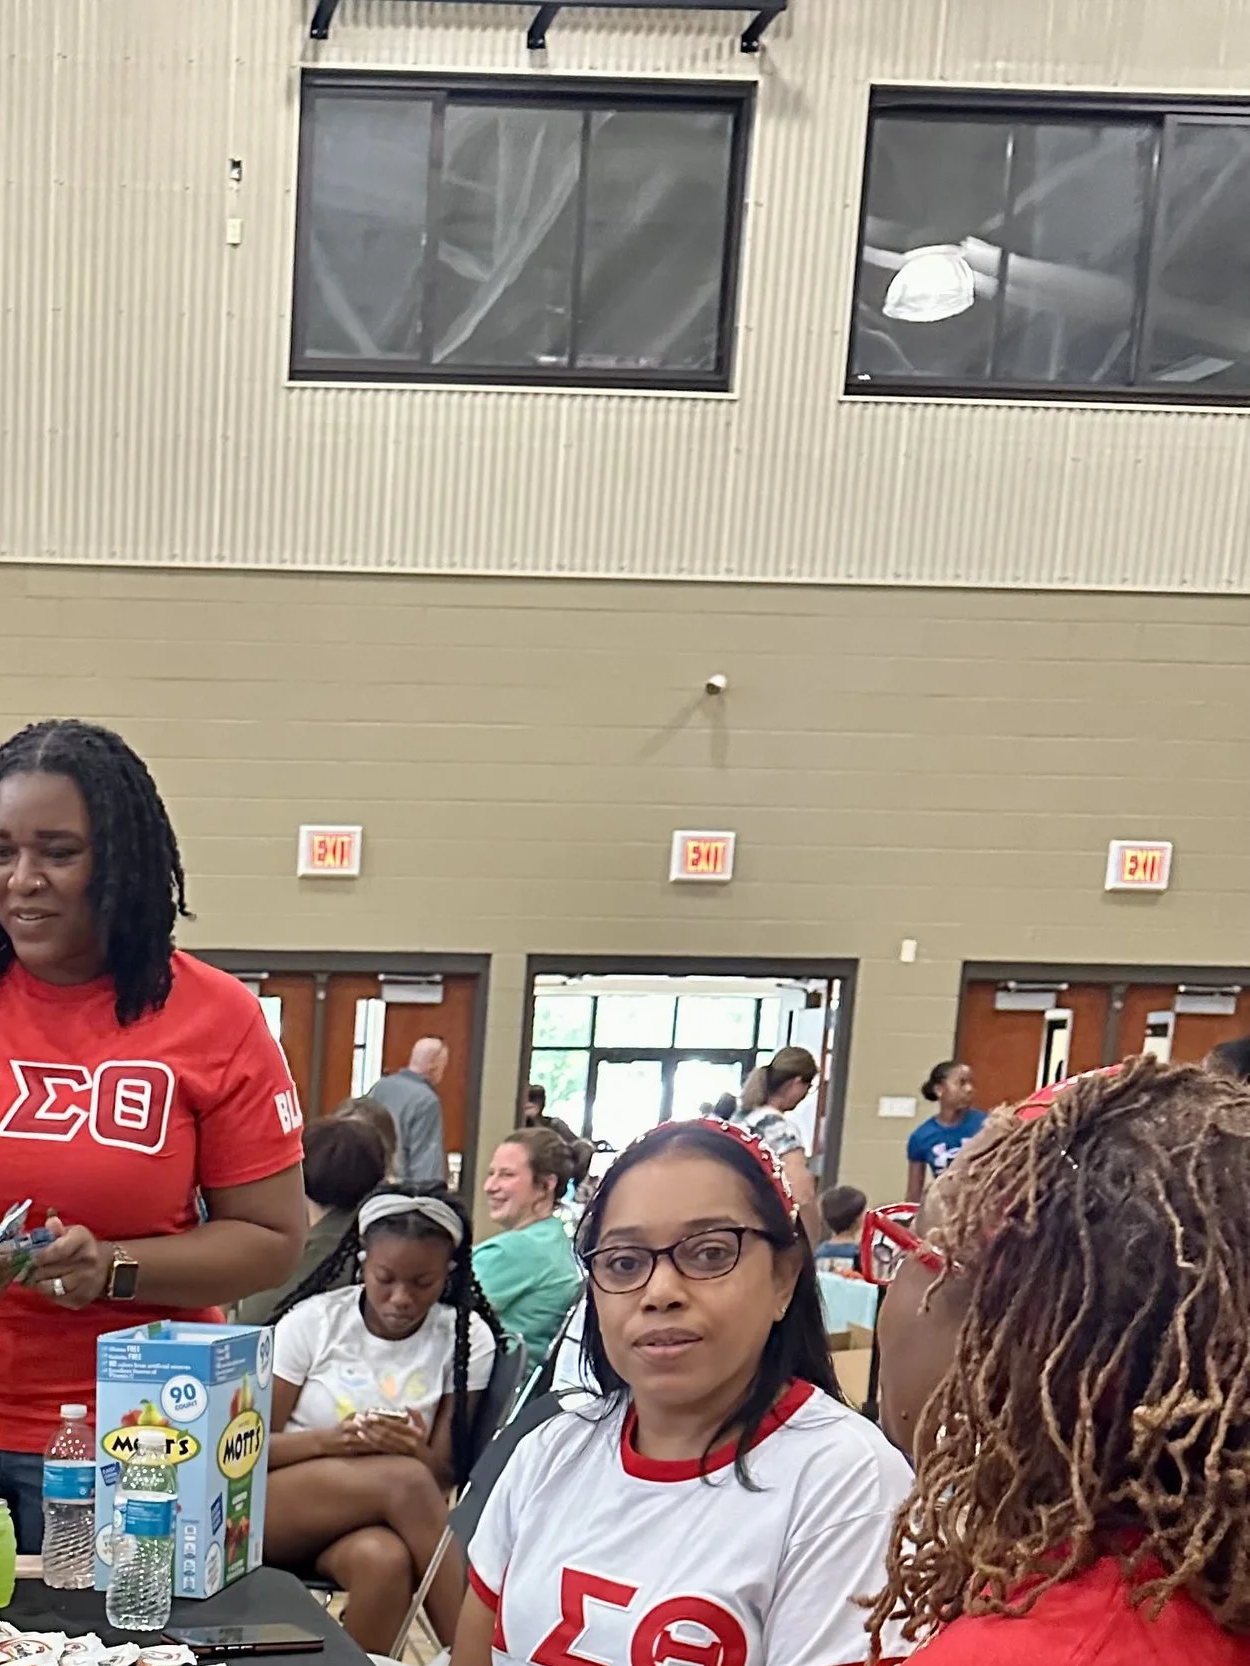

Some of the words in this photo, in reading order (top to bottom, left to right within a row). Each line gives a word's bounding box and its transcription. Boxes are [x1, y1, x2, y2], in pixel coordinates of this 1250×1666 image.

[313, 835, 350, 866] EXIT
[686, 840, 726, 872] EXIT
[1124, 849, 1161, 881] EXIT
[169, 1383, 197, 1403] 90
[174, 1400, 198, 1411] COUNT
